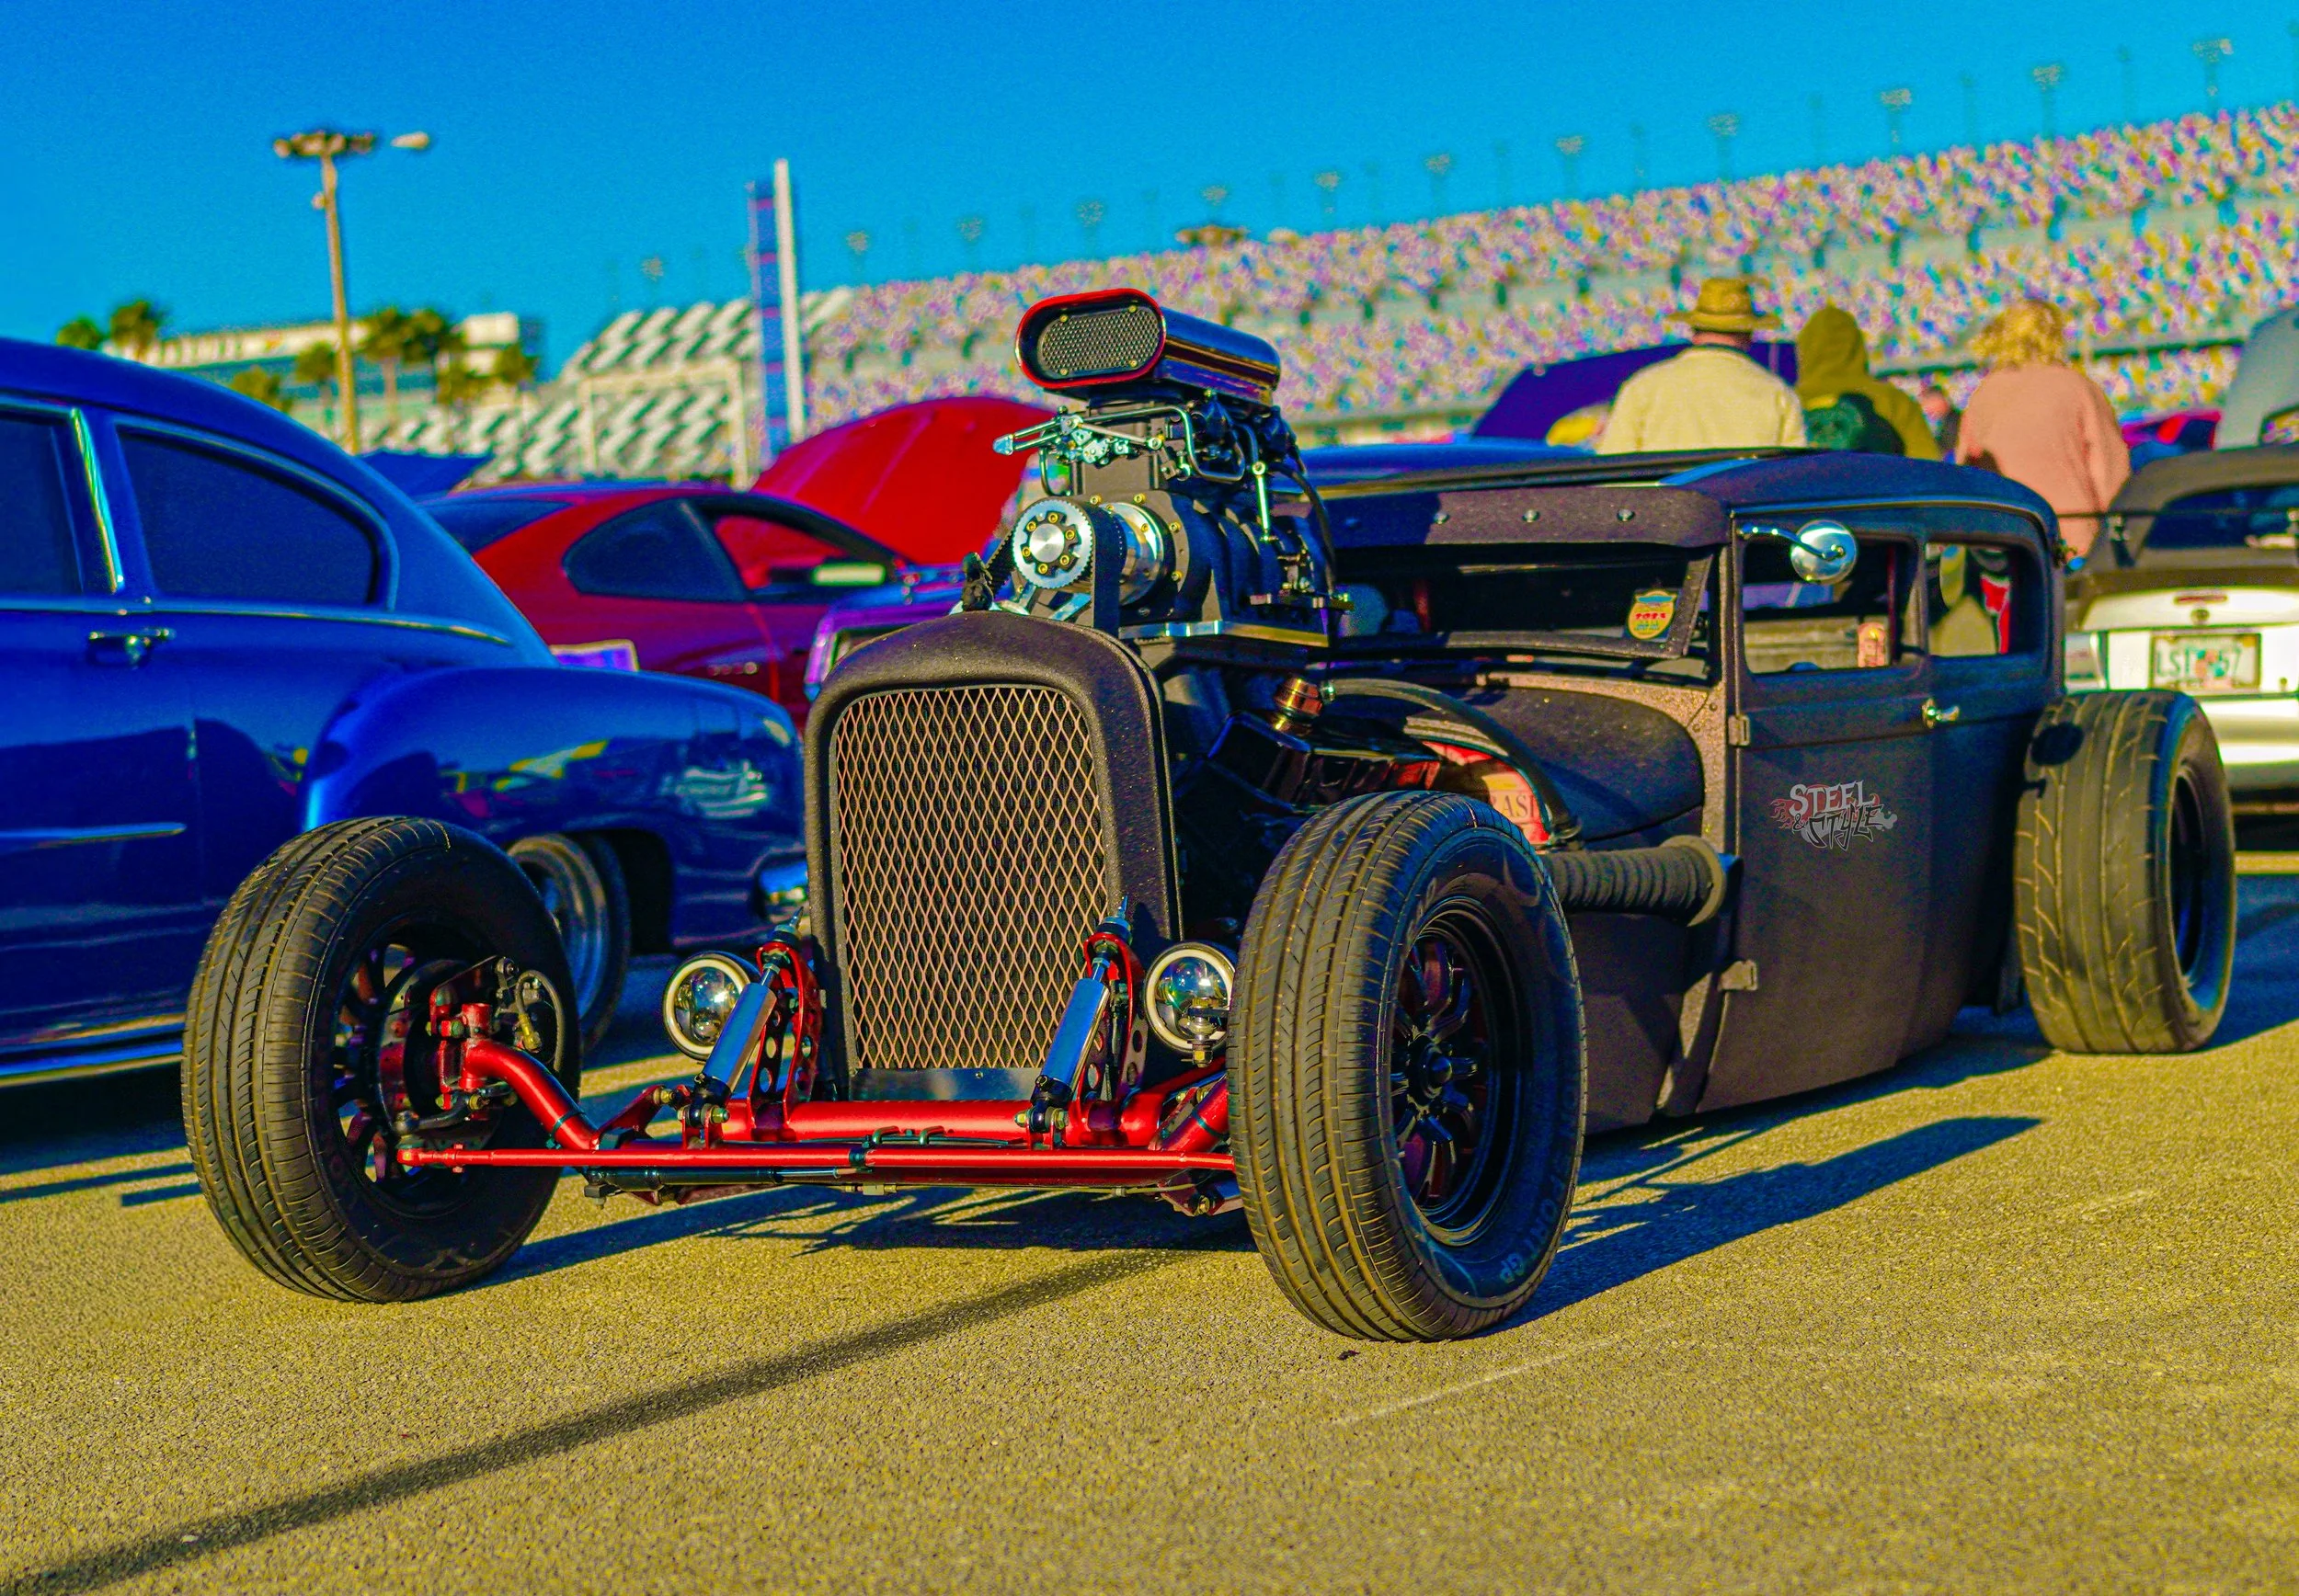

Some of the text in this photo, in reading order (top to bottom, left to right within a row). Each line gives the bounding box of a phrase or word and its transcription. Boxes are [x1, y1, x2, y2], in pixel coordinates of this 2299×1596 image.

[1789, 780, 1876, 816] STEEL
[1805, 803, 1885, 852] STYLE
[1498, 1252, 1526, 1284] GP
